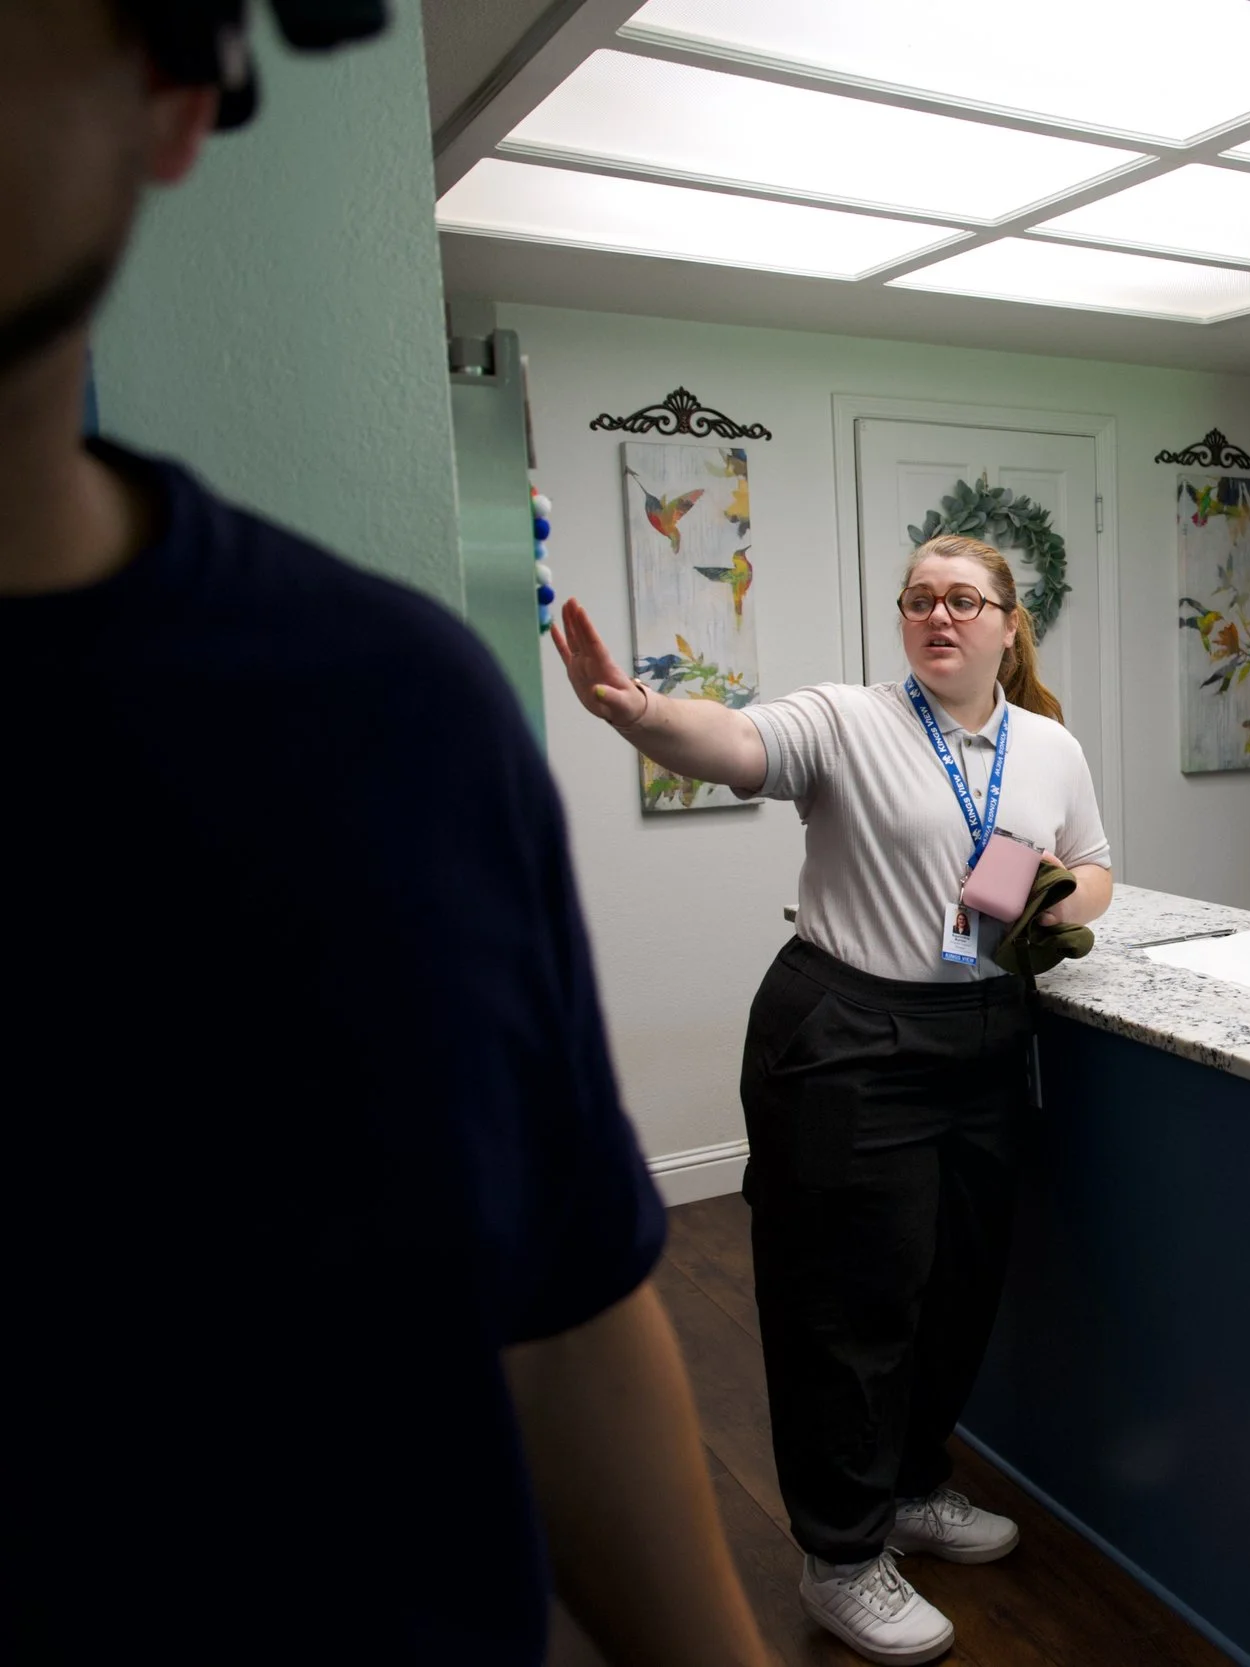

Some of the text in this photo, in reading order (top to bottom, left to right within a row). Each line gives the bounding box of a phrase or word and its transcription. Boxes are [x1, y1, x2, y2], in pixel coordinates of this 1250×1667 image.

[919, 706, 947, 753] KINGS VIEW
[994, 732, 1007, 777] KINGS VIEW
[953, 774, 978, 826] KINGS VIEW
[981, 797, 998, 847] KINGS VIEW
